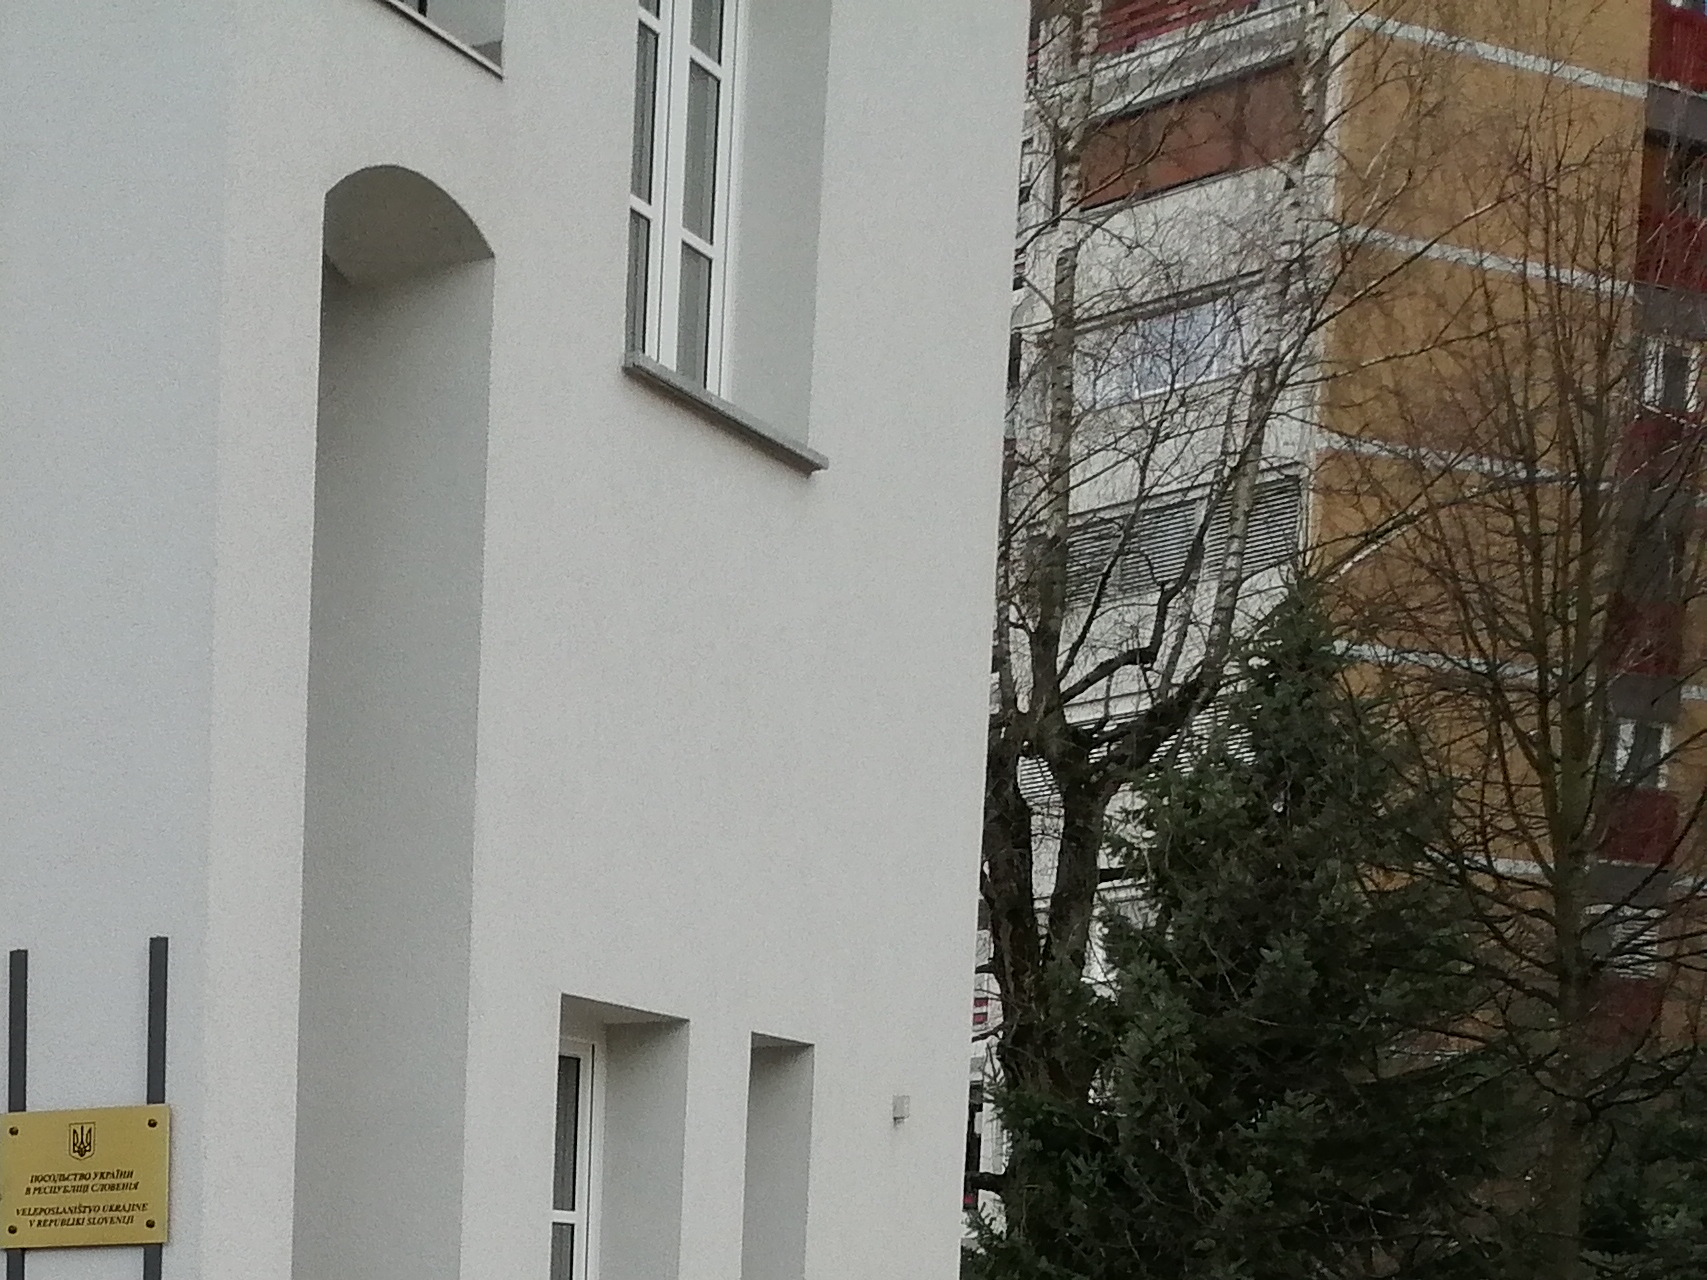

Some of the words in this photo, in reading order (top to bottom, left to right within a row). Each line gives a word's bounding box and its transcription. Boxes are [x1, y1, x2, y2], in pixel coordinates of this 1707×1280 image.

[30, 1172, 91, 1183] ПОСОЛЬСТВО
[93, 1169, 134, 1180] УКРАЇНИ
[25, 1187, 31, 1195] В
[16, 1202, 100, 1216] VELEPOSLANIŠTVO
[102, 1203, 148, 1213] UKRAJINE
[36, 1217, 85, 1227] REPUBLIKI
[87, 1215, 134, 1225] SLOVENIJI
